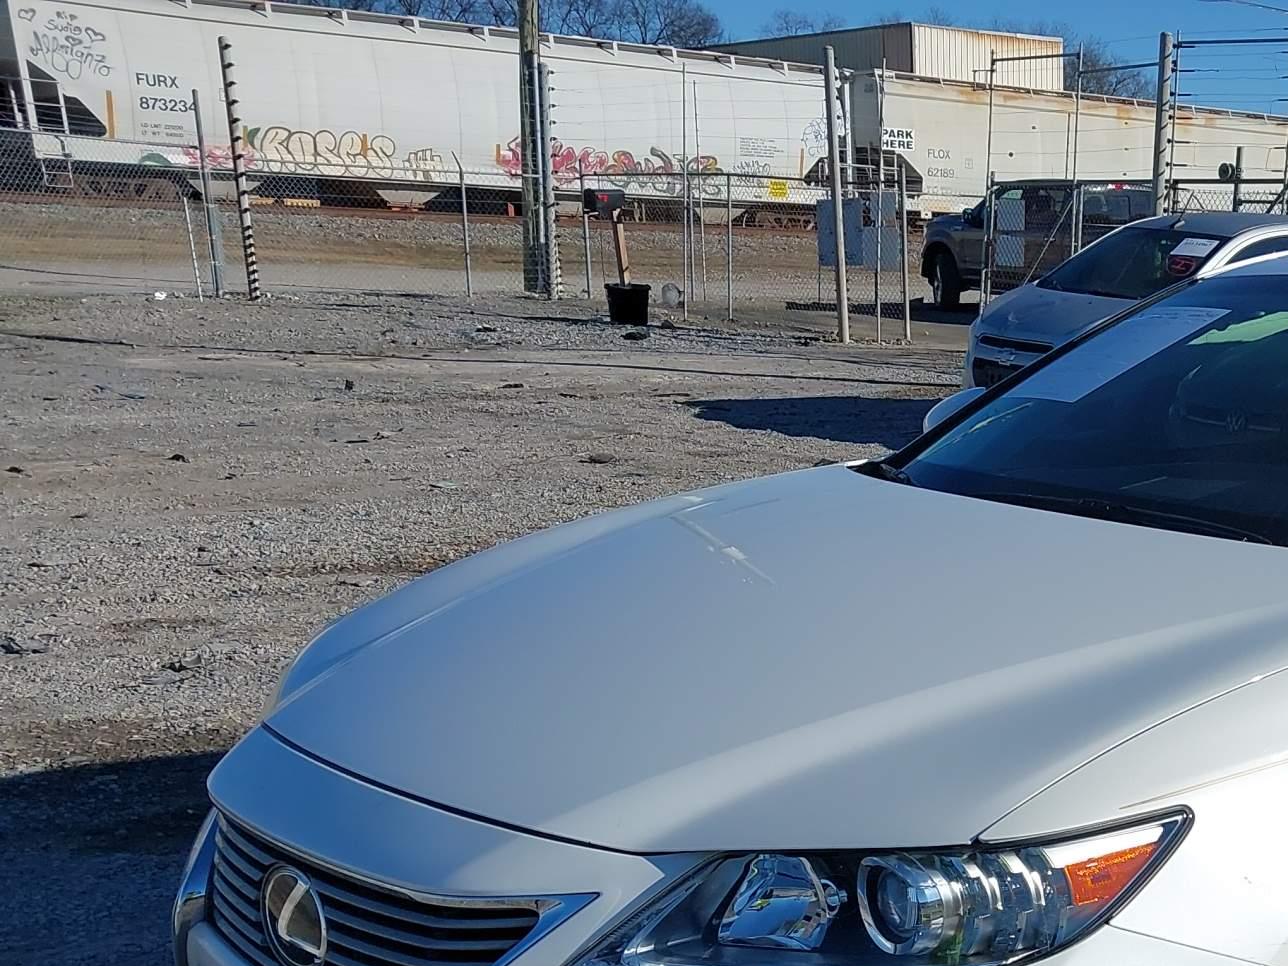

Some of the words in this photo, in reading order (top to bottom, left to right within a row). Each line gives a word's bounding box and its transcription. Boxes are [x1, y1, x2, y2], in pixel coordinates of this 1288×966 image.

[135, 72, 179, 89] FURX
[139, 96, 198, 113] 873234
[882, 129, 913, 139] PARK
[882, 140, 913, 150] HERE
[927, 148, 951, 160] FLOX
[927, 167, 955, 179] 62189
